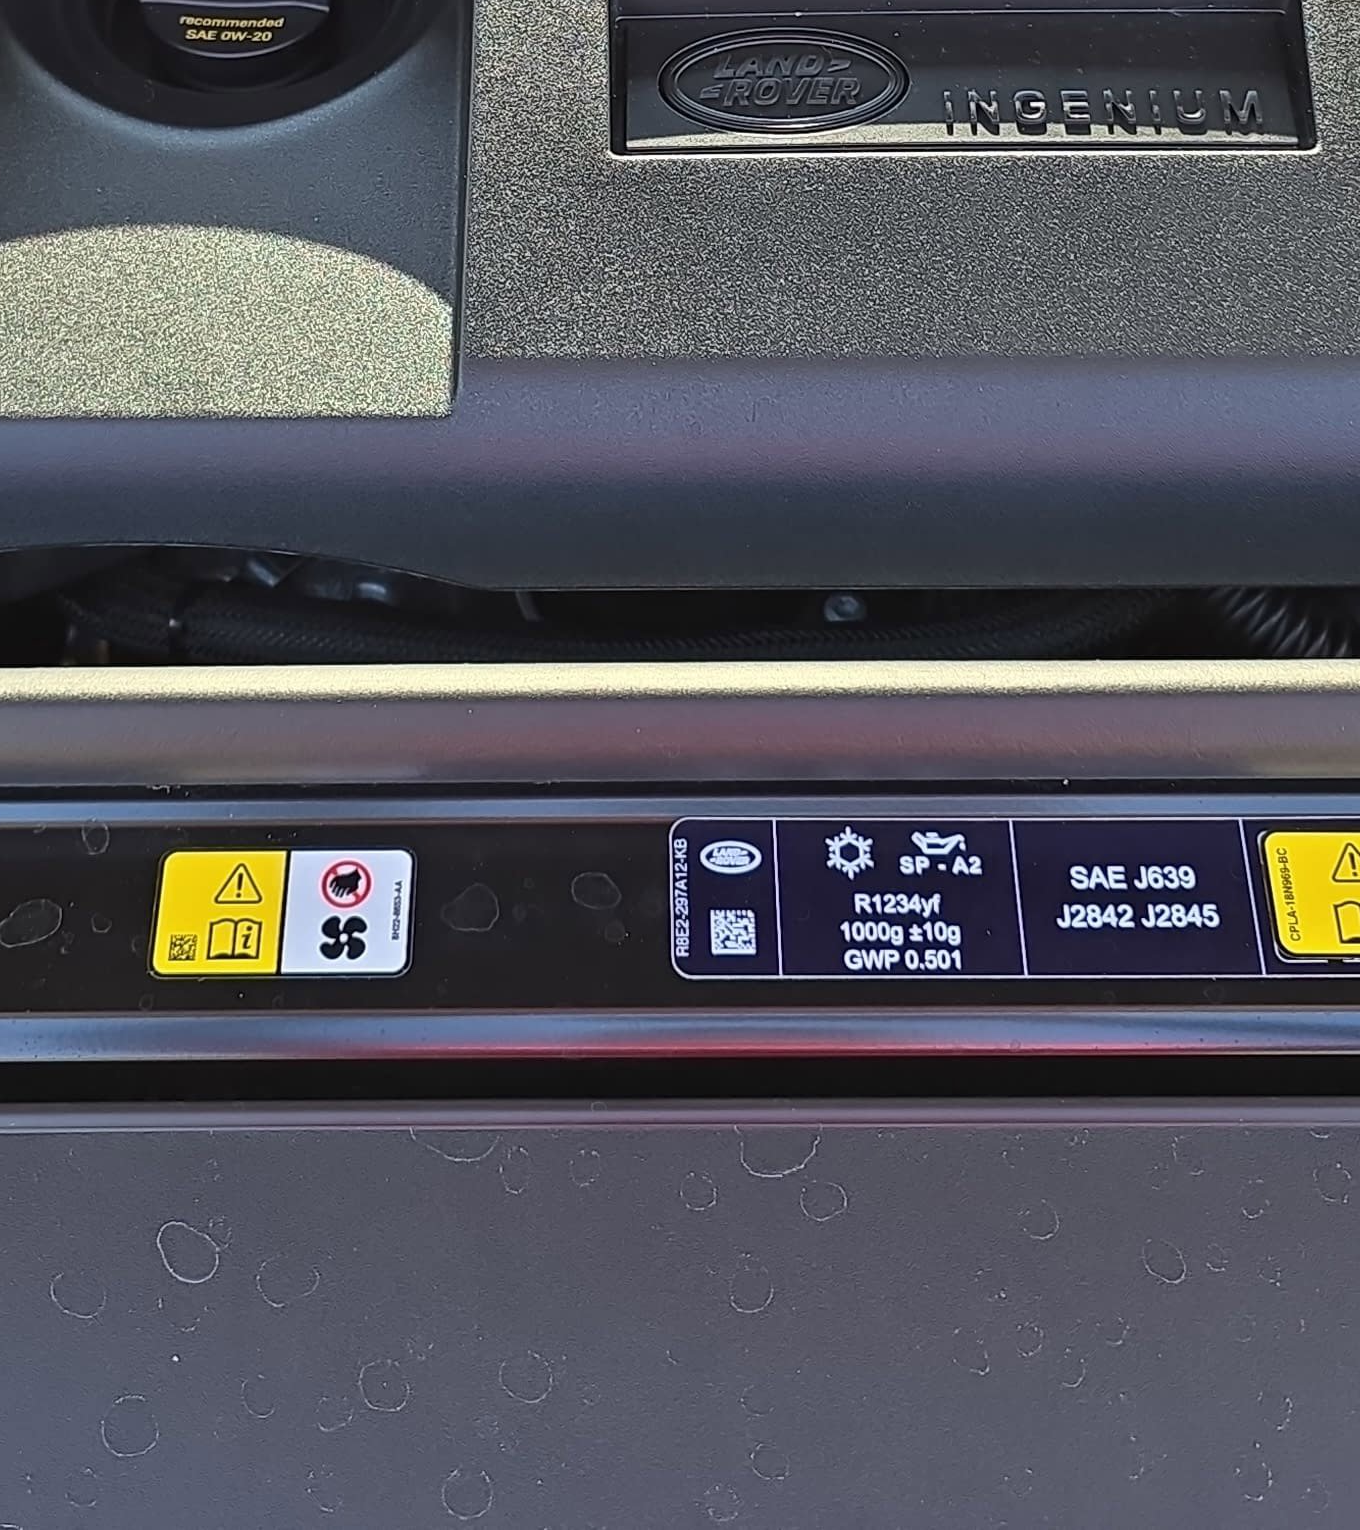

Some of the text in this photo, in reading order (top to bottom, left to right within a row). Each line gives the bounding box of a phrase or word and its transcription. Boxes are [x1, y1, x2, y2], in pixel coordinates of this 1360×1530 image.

[180, 16, 284, 28] recommended
[185, 29, 273, 42] SAE 0W-20
[714, 55, 824, 79] LAND
[723, 78, 861, 106] ROVER
[942, 88, 1264, 125] INGENIUM
[900, 856, 931, 875] SP
[952, 856, 983, 875] A2
[1069, 865, 1196, 889] SAE J639
[854, 893, 942, 915] R1234yf
[1056, 903, 1220, 929] J2842 J2845
[840, 923, 962, 947] 1000g ±10g
[844, 951, 962, 970] GWP 0.501
